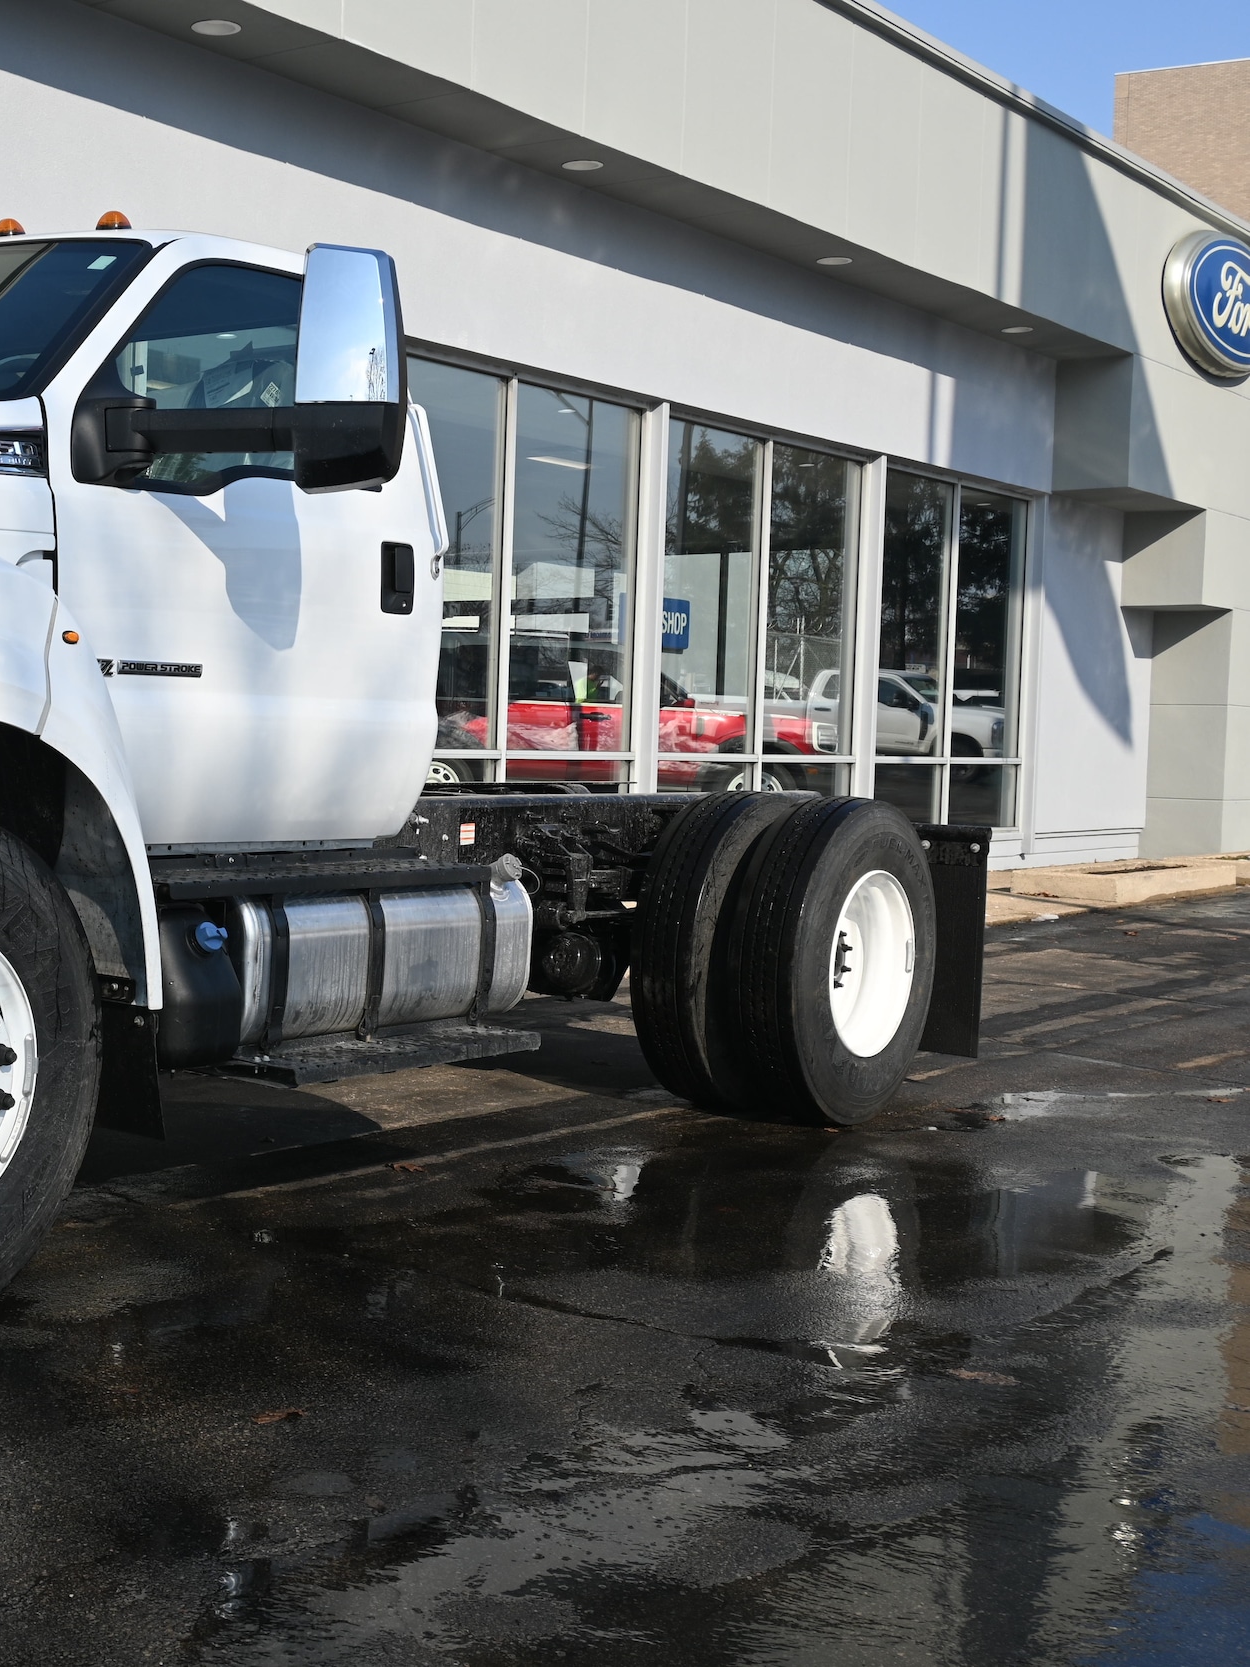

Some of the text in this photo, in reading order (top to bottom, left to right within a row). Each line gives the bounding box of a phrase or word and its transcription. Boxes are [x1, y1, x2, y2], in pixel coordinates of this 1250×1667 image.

[1212, 260, 1250, 337] For
[662, 611, 687, 635] SHOP
[121, 662, 158, 672] POWER
[159, 663, 202, 673] STROKE
